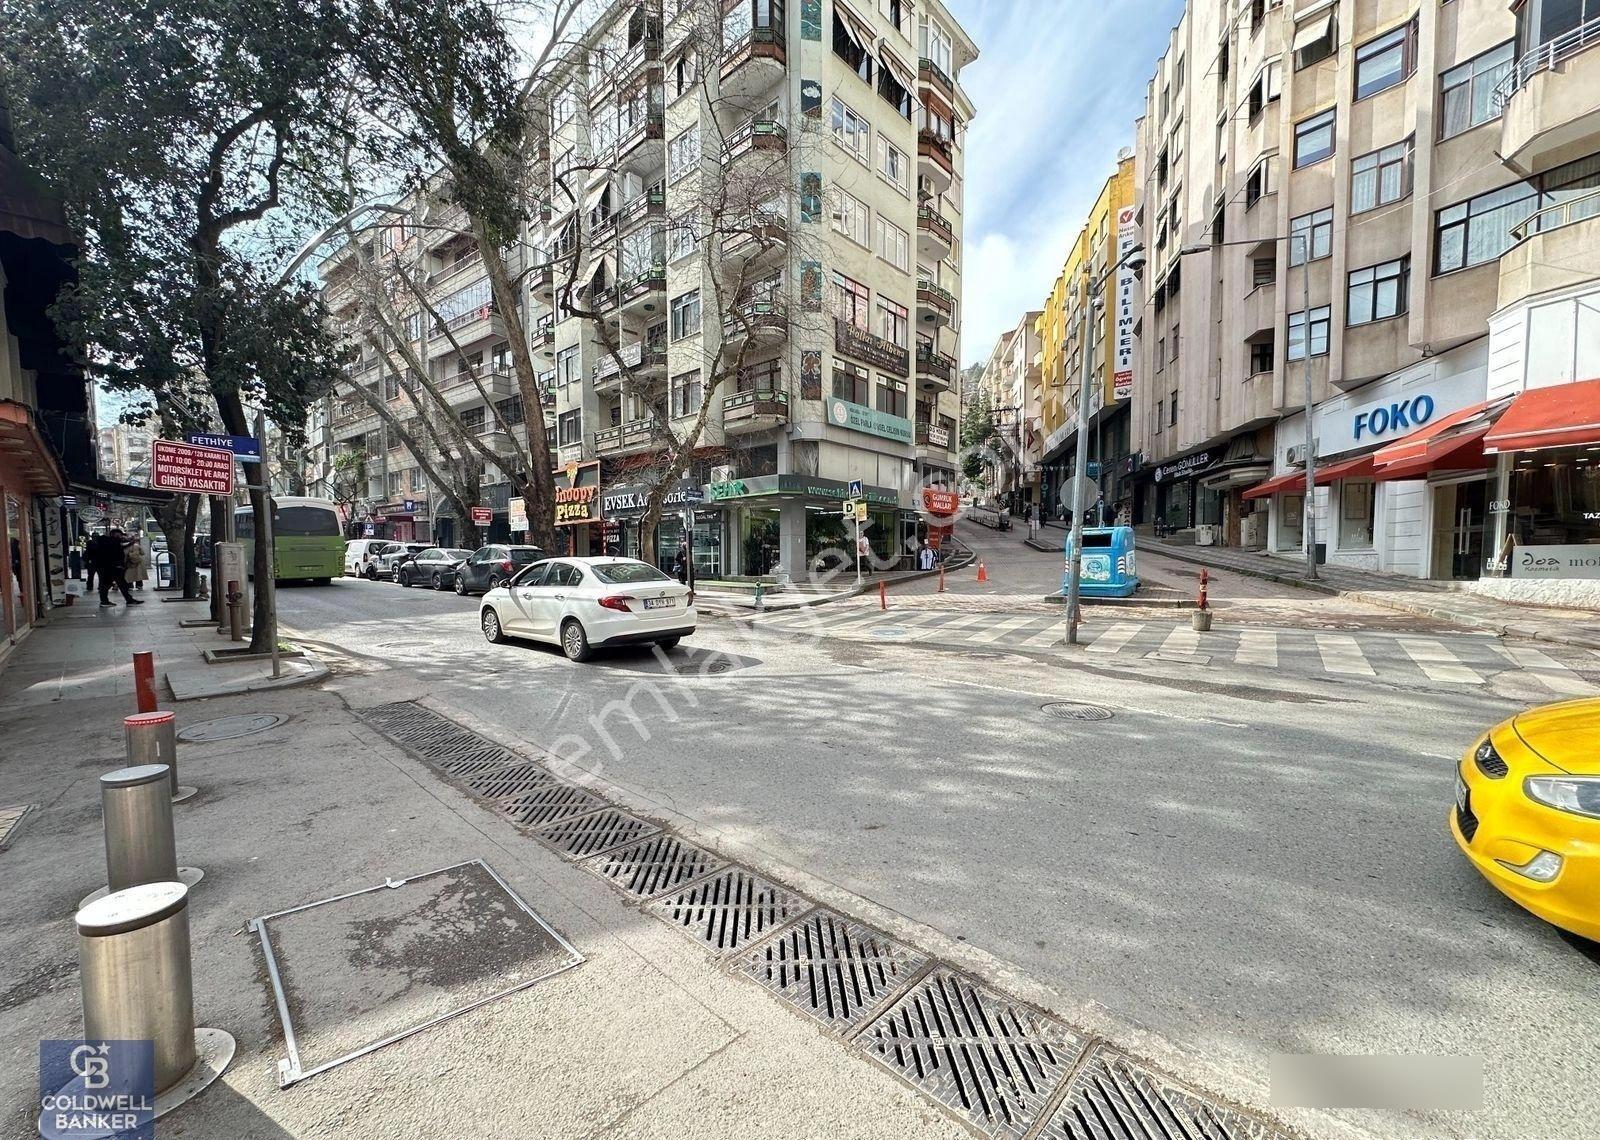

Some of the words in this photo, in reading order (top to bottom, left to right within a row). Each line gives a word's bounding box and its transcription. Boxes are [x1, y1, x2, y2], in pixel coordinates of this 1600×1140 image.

[1353, 394, 1434, 440] FOKO
[191, 436, 233, 447] FETHİYE
[157, 454, 174, 463] SAAT
[175, 457, 192, 465] 10:00
[196, 460, 213, 468] 20:00
[213, 462, 229, 470] ARASI
[157, 464, 203, 477] MOTORSİKLET
[203, 469, 213, 478] VE
[212, 471, 229, 480] ARAÇ
[161, 474, 186, 488] GİRİŞİ
[187, 478, 226, 490] YASAKTIR
[604, 492, 636, 511] EVSEK
[846, 503, 853, 512] D
[1489, 499, 1511, 511] FOKO
[556, 503, 589, 520] Pizza
